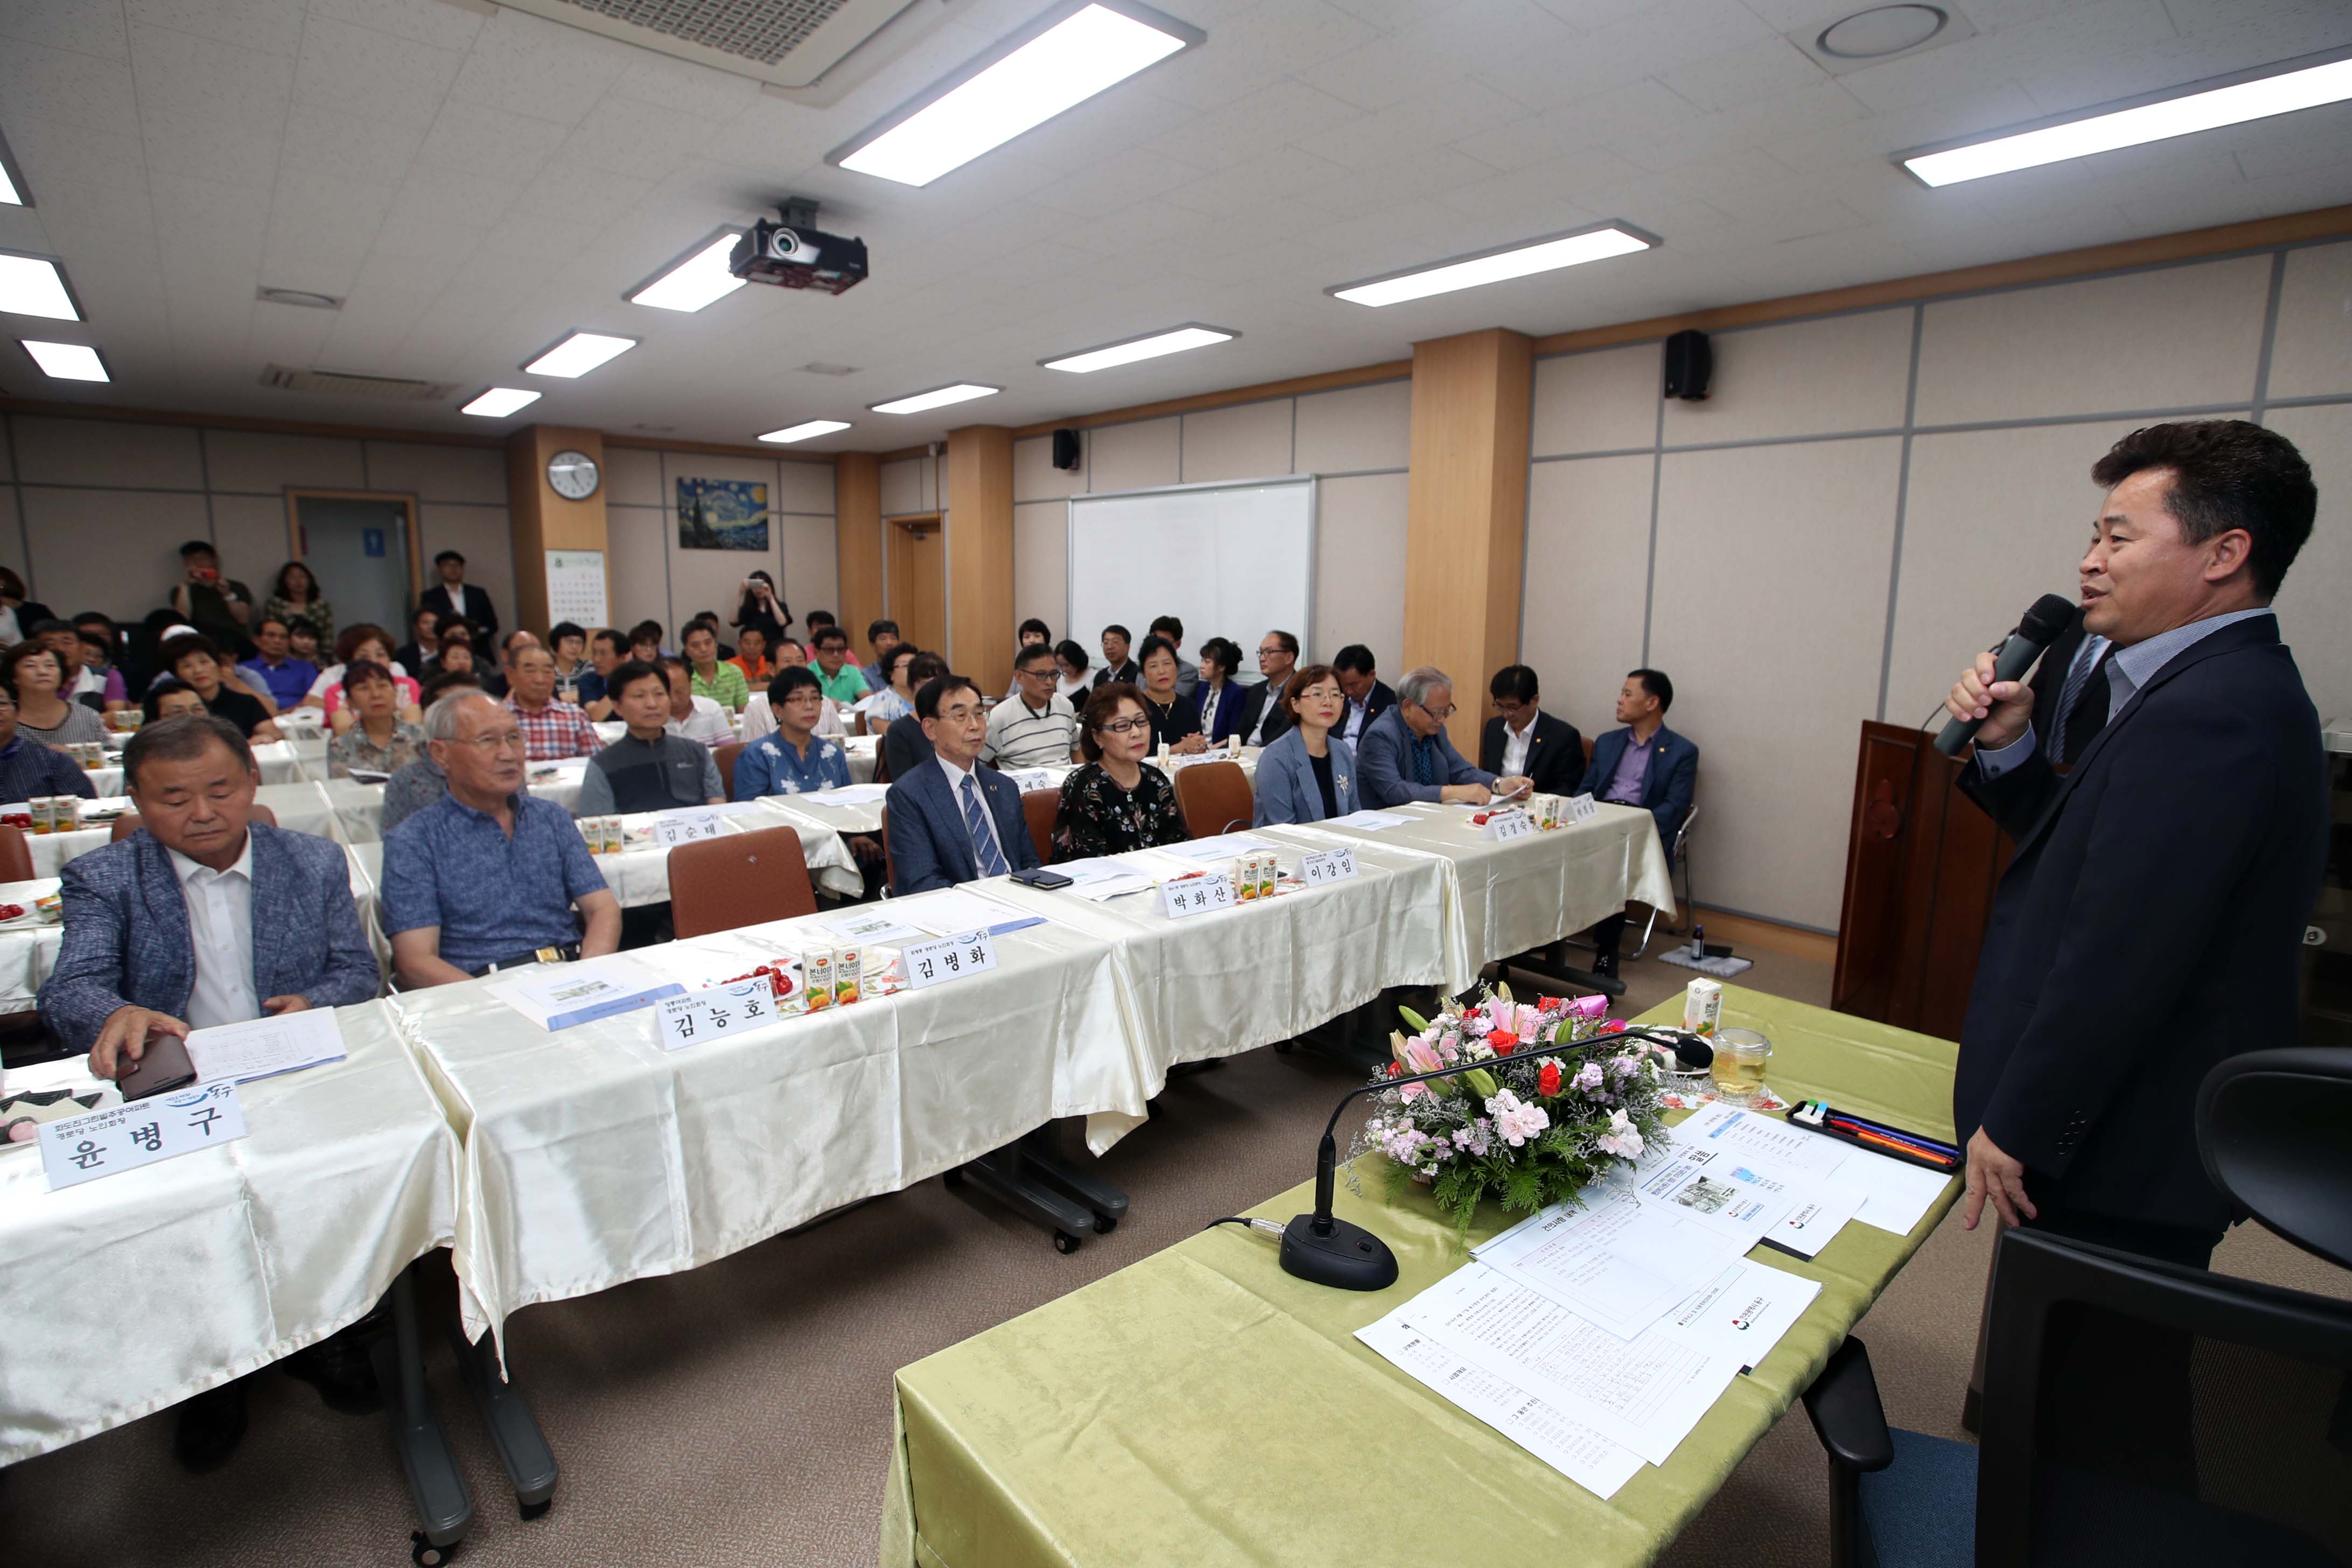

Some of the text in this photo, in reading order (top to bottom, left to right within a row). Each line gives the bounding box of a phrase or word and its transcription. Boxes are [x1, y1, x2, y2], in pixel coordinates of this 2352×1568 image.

[55, 1102, 151, 1132] 화도진그린빌주공아파트
[56, 1117, 127, 1140] 경로당 노인회장
[68, 1107, 222, 1170] 윤 병 구
[1688, 1150, 1711, 1163] 말씀
[1542, 1209, 1578, 1231] 건의사항 내역
[1739, 1303, 1759, 1320] 인천광역시
